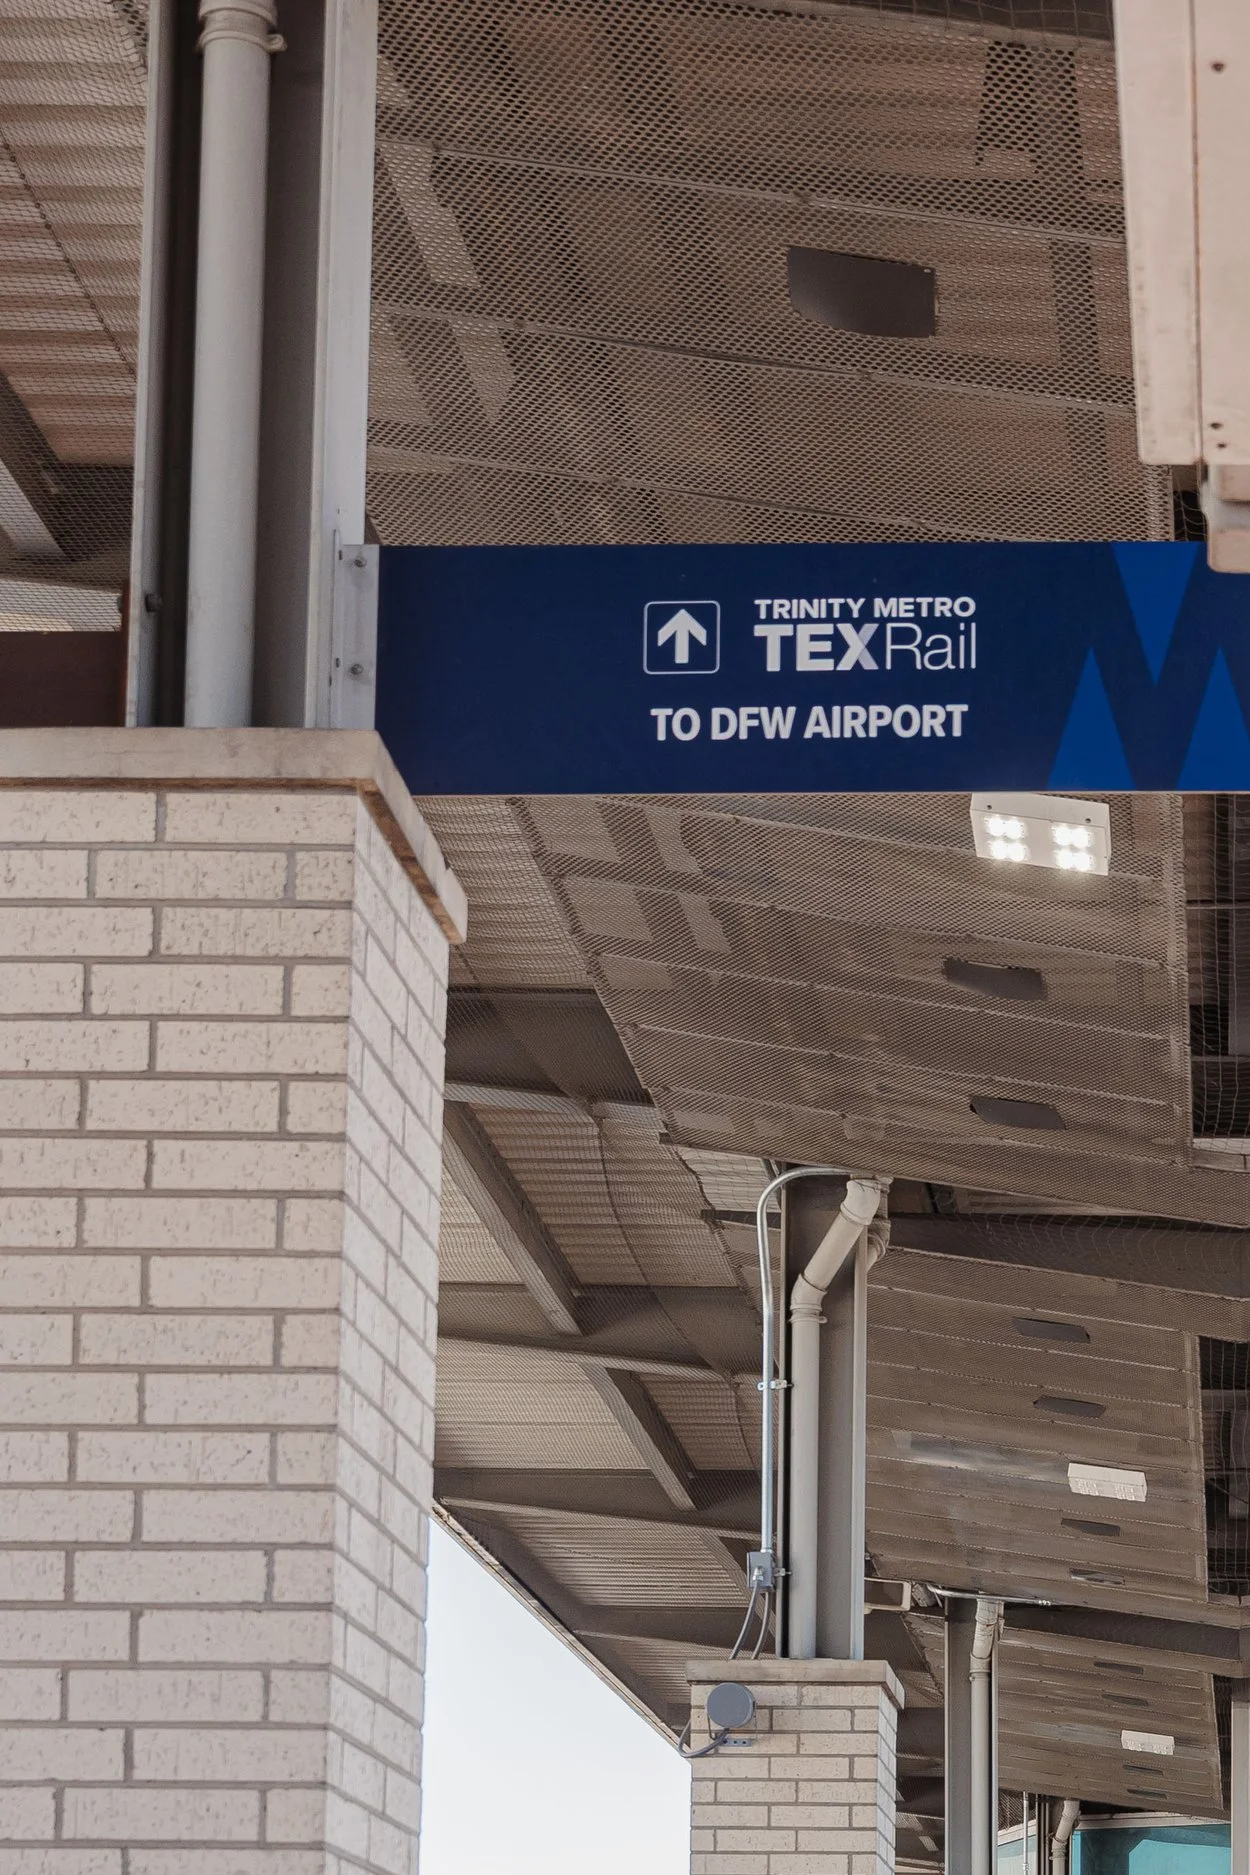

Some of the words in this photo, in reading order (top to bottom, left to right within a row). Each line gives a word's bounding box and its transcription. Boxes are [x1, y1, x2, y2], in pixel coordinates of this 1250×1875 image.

[754, 598, 866, 619] TRINITY
[874, 596, 976, 618] METRO
[650, 707, 701, 741] TO
[711, 706, 796, 740] DFW
[803, 703, 969, 739] AIRPORT
